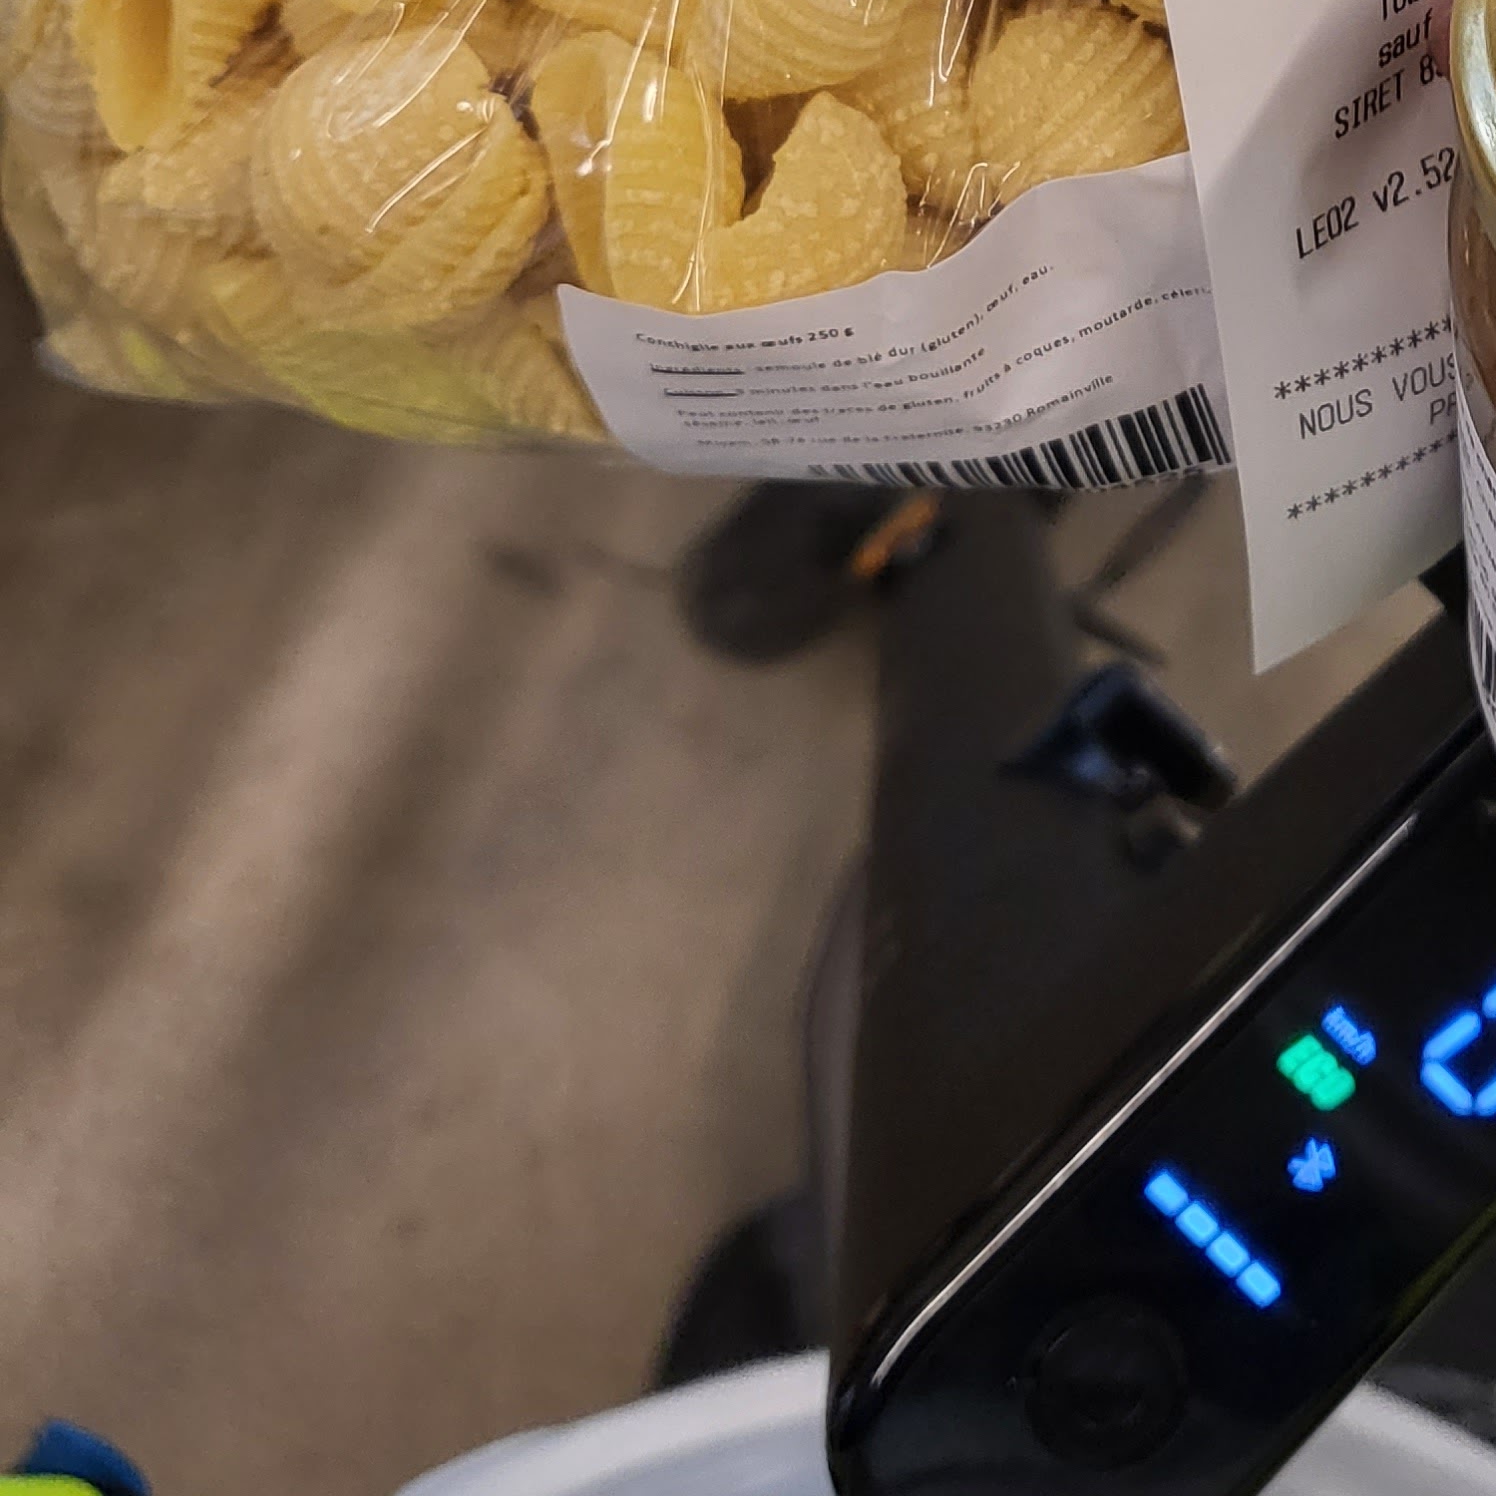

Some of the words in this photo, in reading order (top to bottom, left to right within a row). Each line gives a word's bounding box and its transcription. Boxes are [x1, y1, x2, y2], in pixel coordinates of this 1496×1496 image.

[1379, 8, 1433, 68] sauf
[1335, 69, 1404, 139] SIRET
[807, 327, 839, 342] 250
[833, 359, 852, 368] de
[857, 351, 882, 365] blé
[888, 346, 916, 360] dur
[1021, 264, 1055, 286] eau.
[908, 346, 986, 383] bouillante
[963, 371, 1002, 400] fruits
[1015, 334, 1076, 367] coques,
[1078, 294, 1159, 340] moutarde,
[1026, 375, 1114, 419] Romainville
[1299, 389, 1372, 439] NOUS
